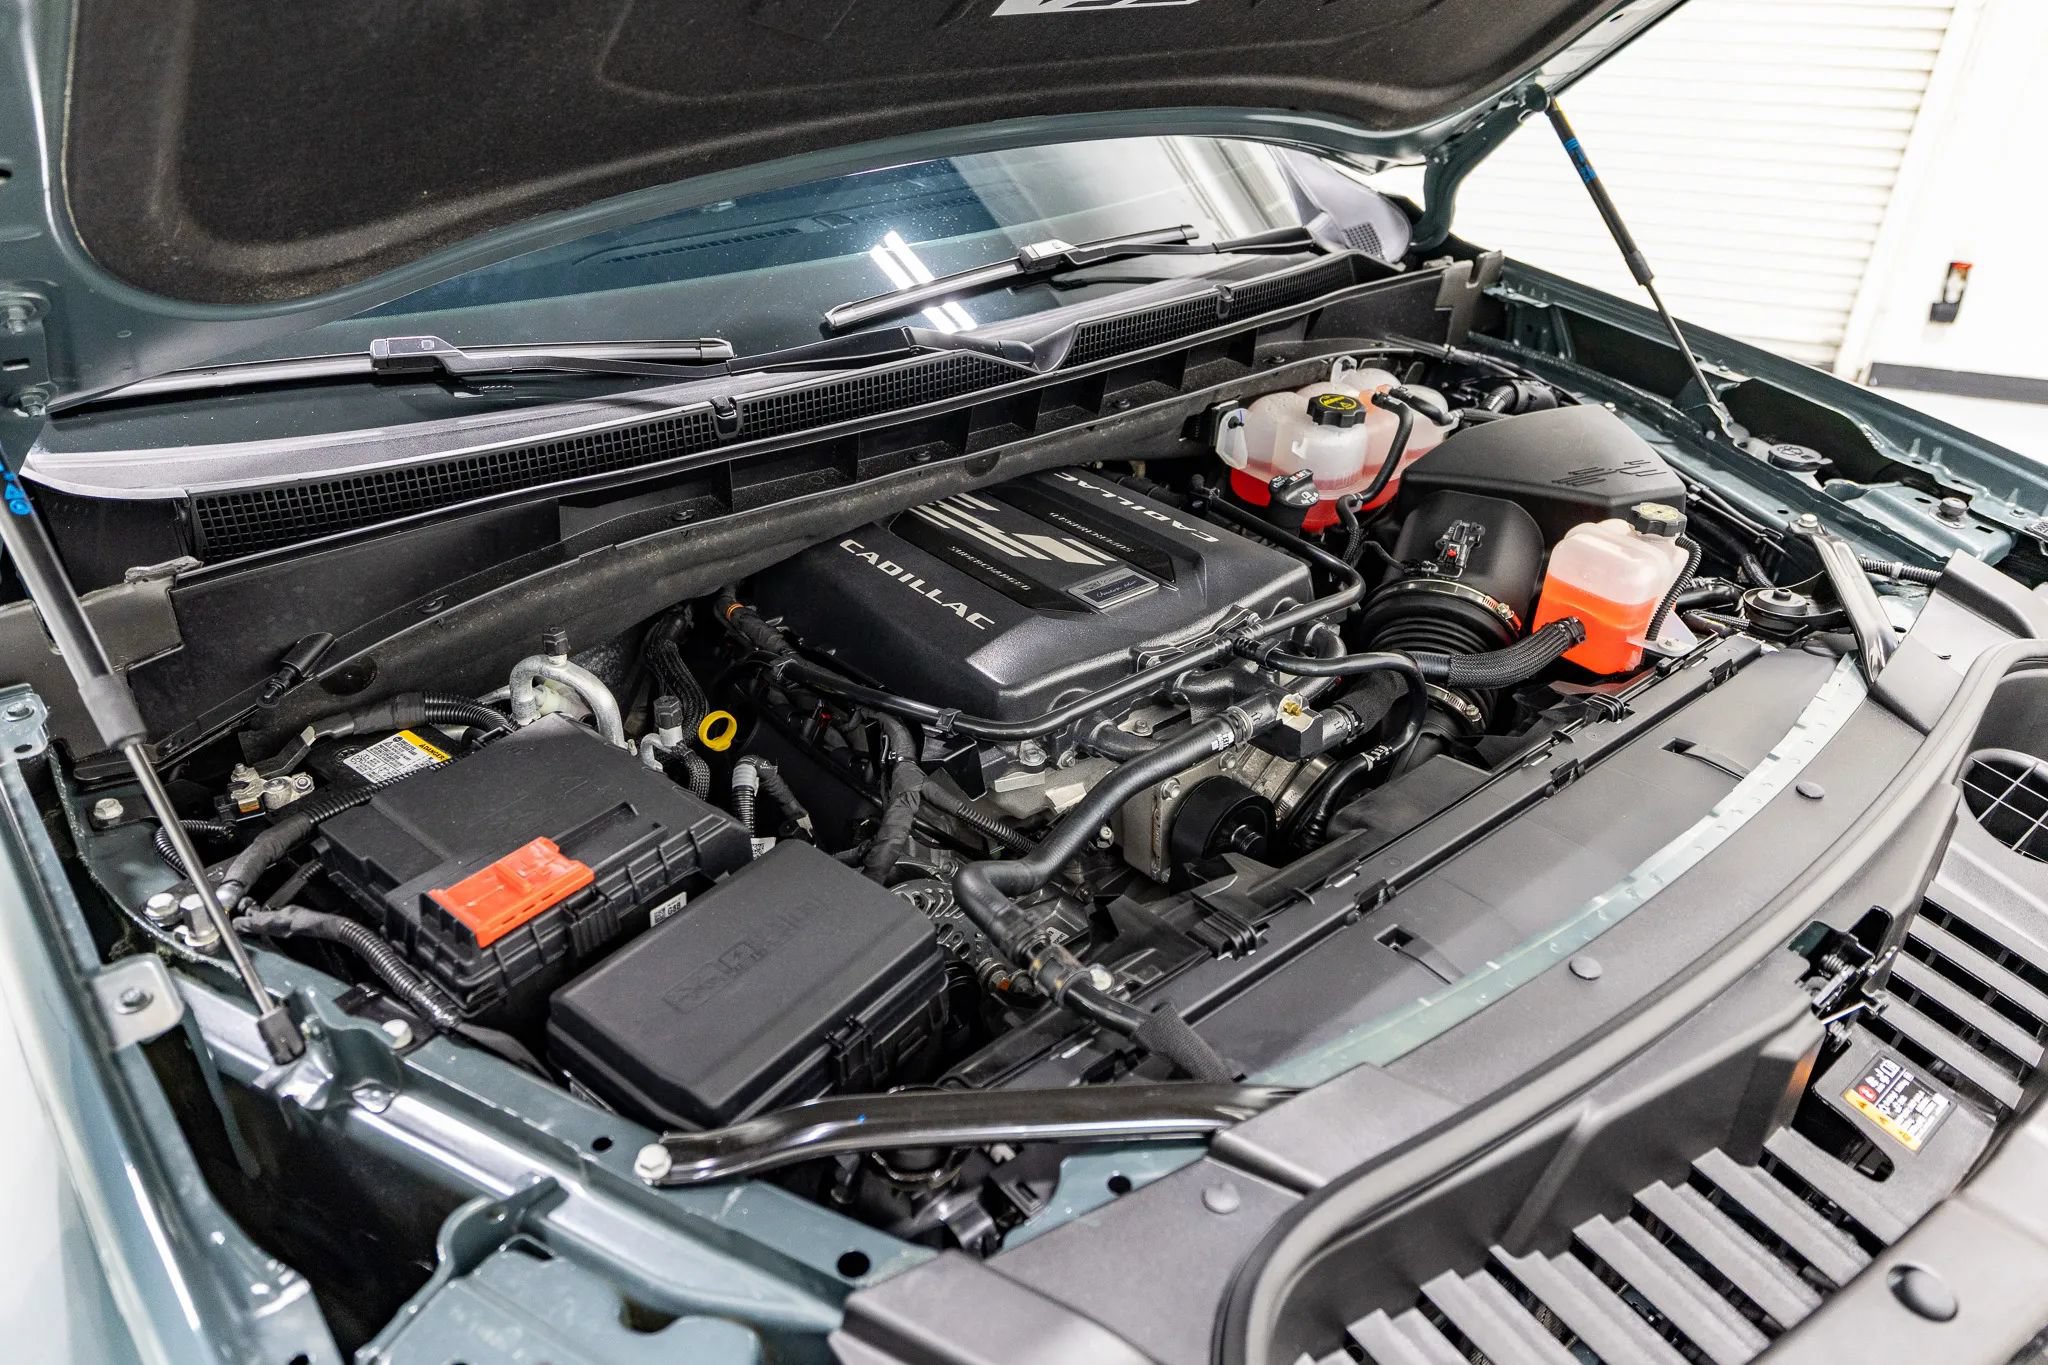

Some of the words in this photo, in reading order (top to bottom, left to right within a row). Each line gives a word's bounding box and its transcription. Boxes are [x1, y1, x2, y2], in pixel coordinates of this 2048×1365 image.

[1053, 472, 1220, 543] CADILLAC
[1050, 512, 1134, 552] SUPERCHARGED
[839, 539, 996, 630] CADILLAC
[948, 546, 1031, 590] SUPERCHARGED
[422, 745, 445, 760] DANGER
